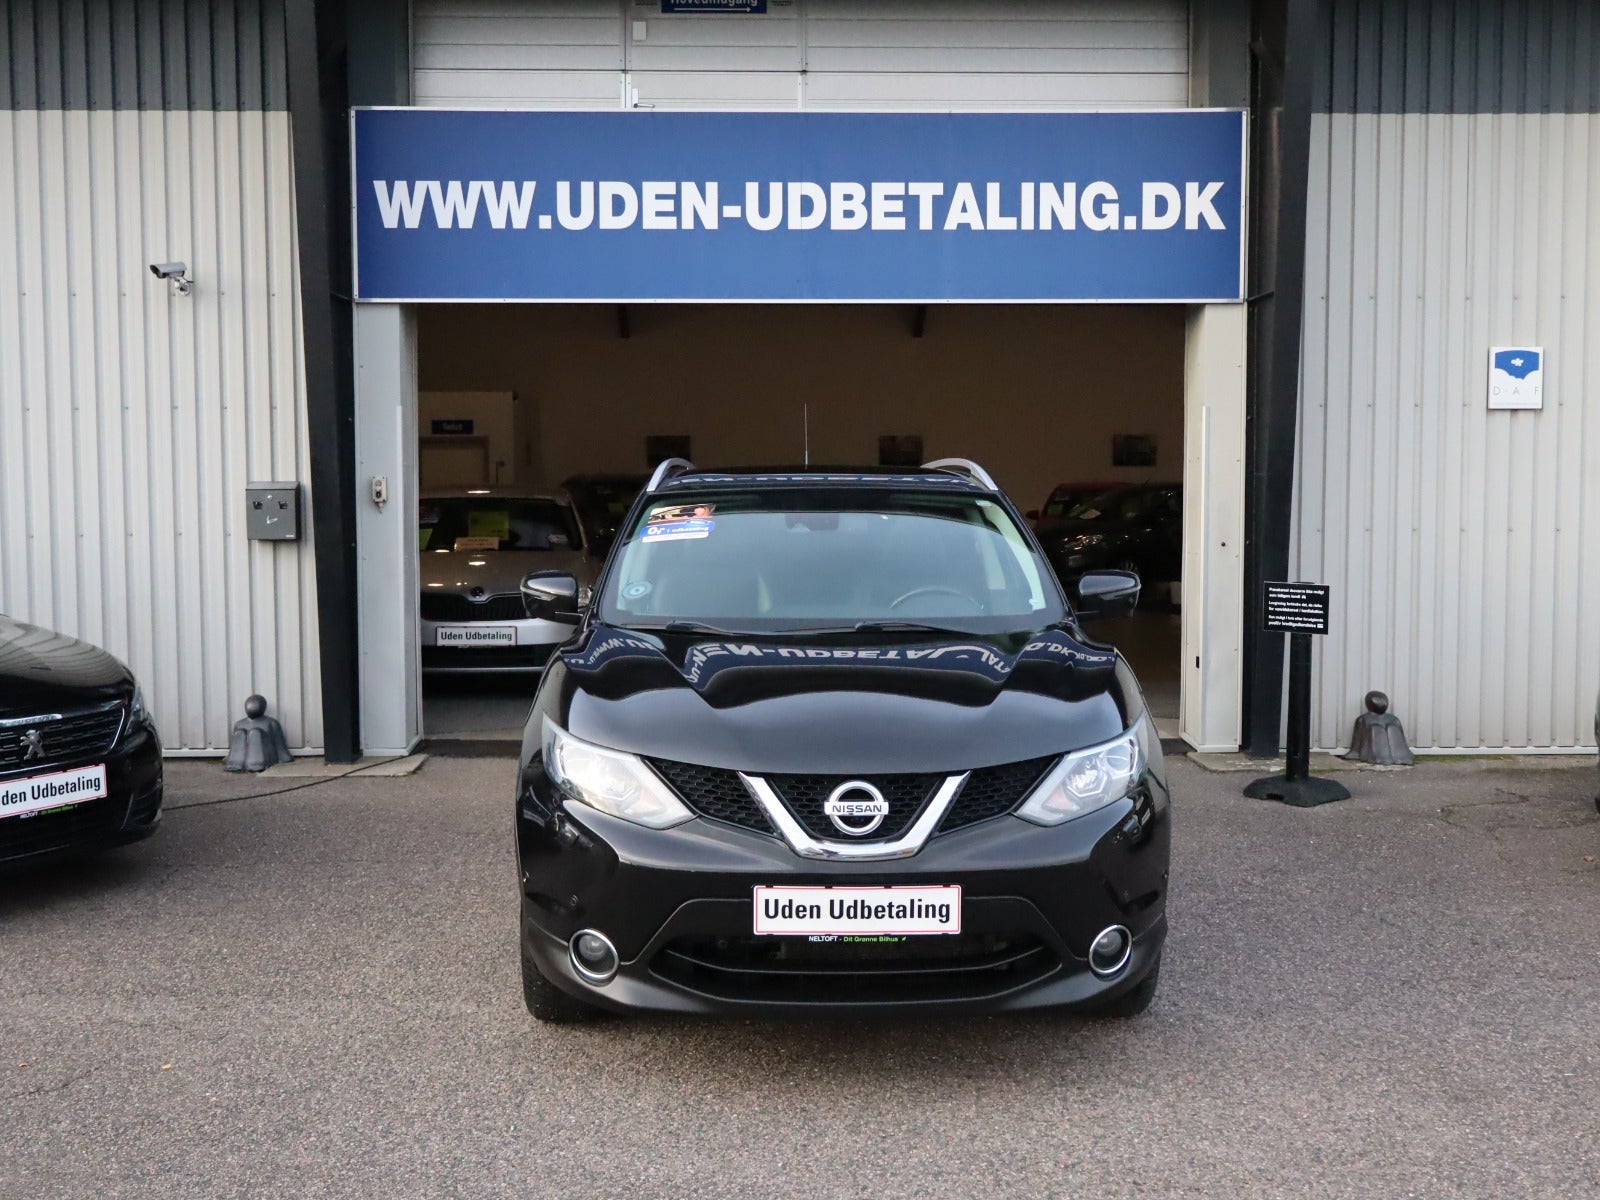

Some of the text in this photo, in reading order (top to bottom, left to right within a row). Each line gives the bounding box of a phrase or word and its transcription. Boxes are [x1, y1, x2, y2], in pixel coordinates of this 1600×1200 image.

[373, 180, 1227, 231] WWW.UDEN-UDBETALING.DK
[440, 631, 512, 641] Uden Udbetaling
[1, 776, 101, 806] den Udbetaling
[832, 804, 882, 813] NISSAN
[764, 898, 950, 924] Uden Udbetaling
